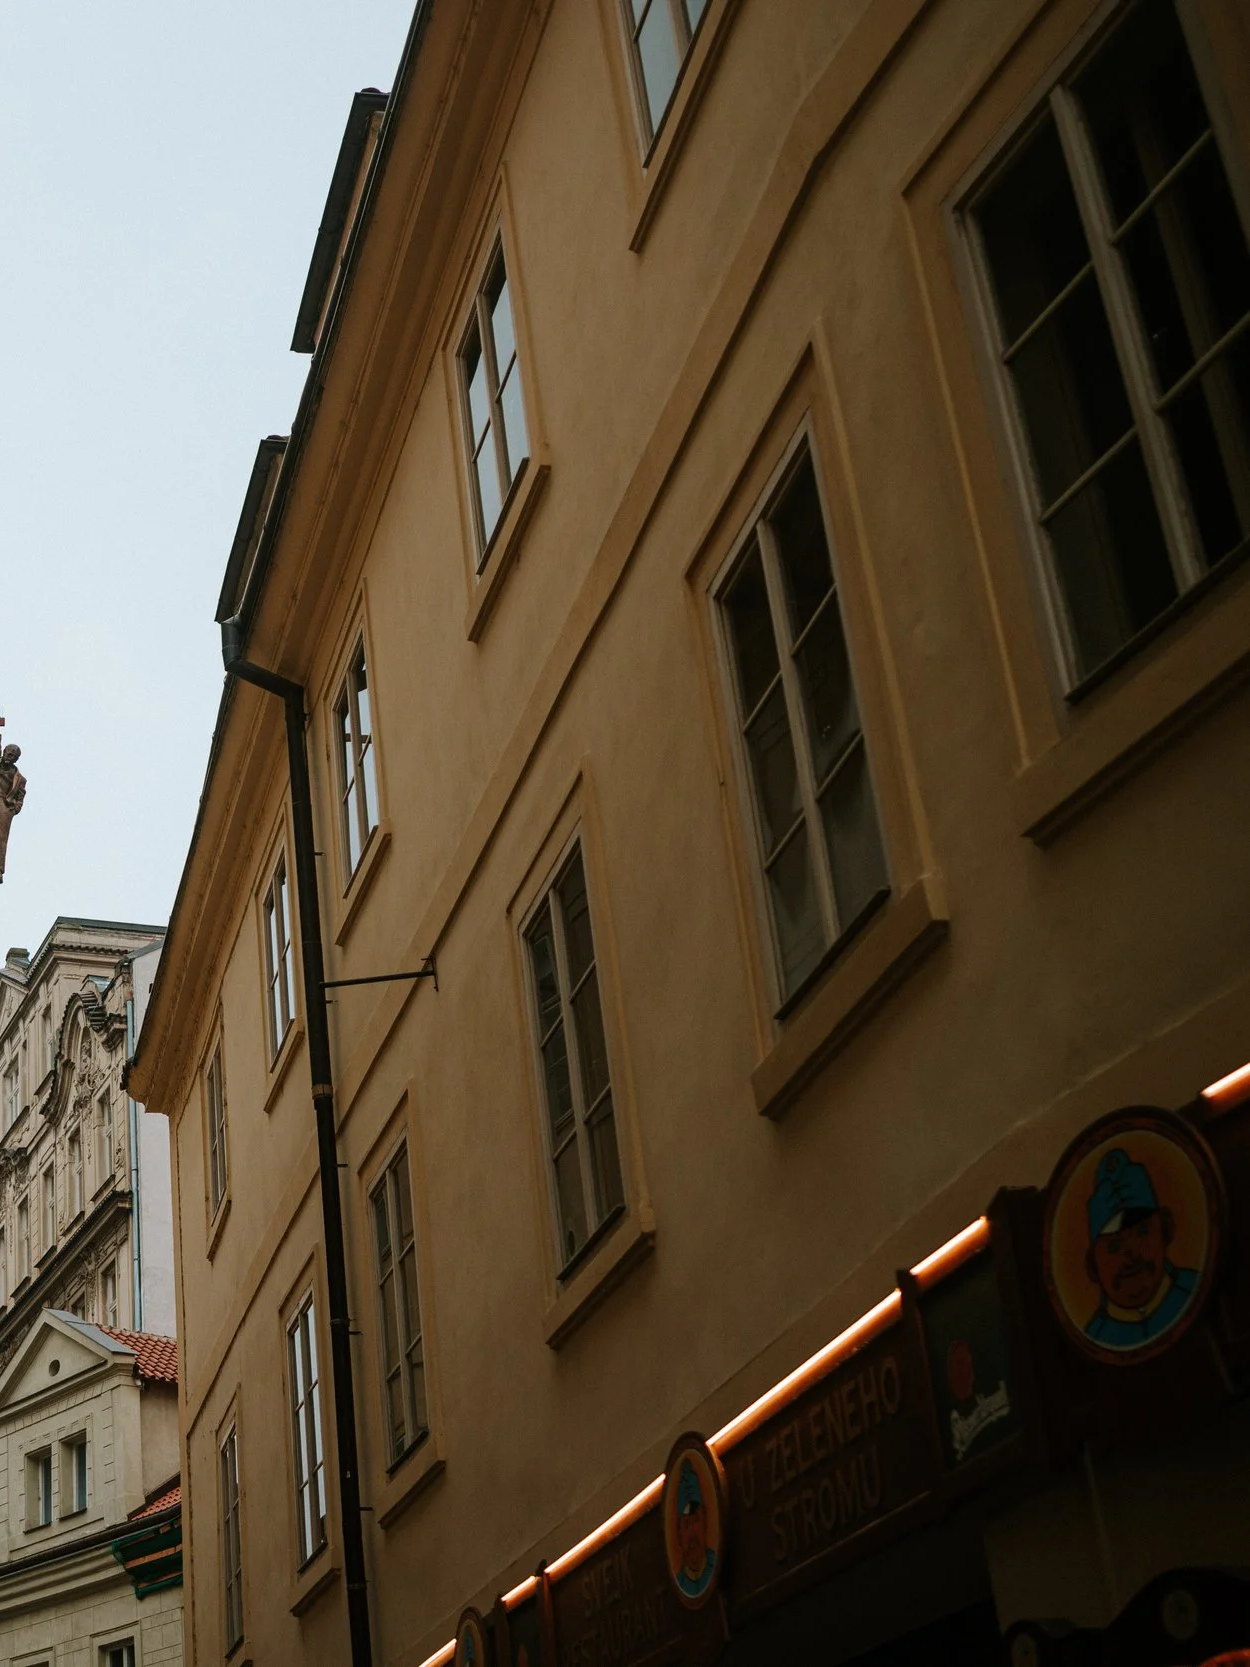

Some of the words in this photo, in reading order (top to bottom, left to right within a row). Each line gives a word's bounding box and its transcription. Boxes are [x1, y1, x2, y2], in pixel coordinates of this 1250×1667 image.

[738, 1453, 755, 1509] U
[765, 1356, 901, 1492] ZELENEHO
[771, 1444, 881, 1561] STROMU
